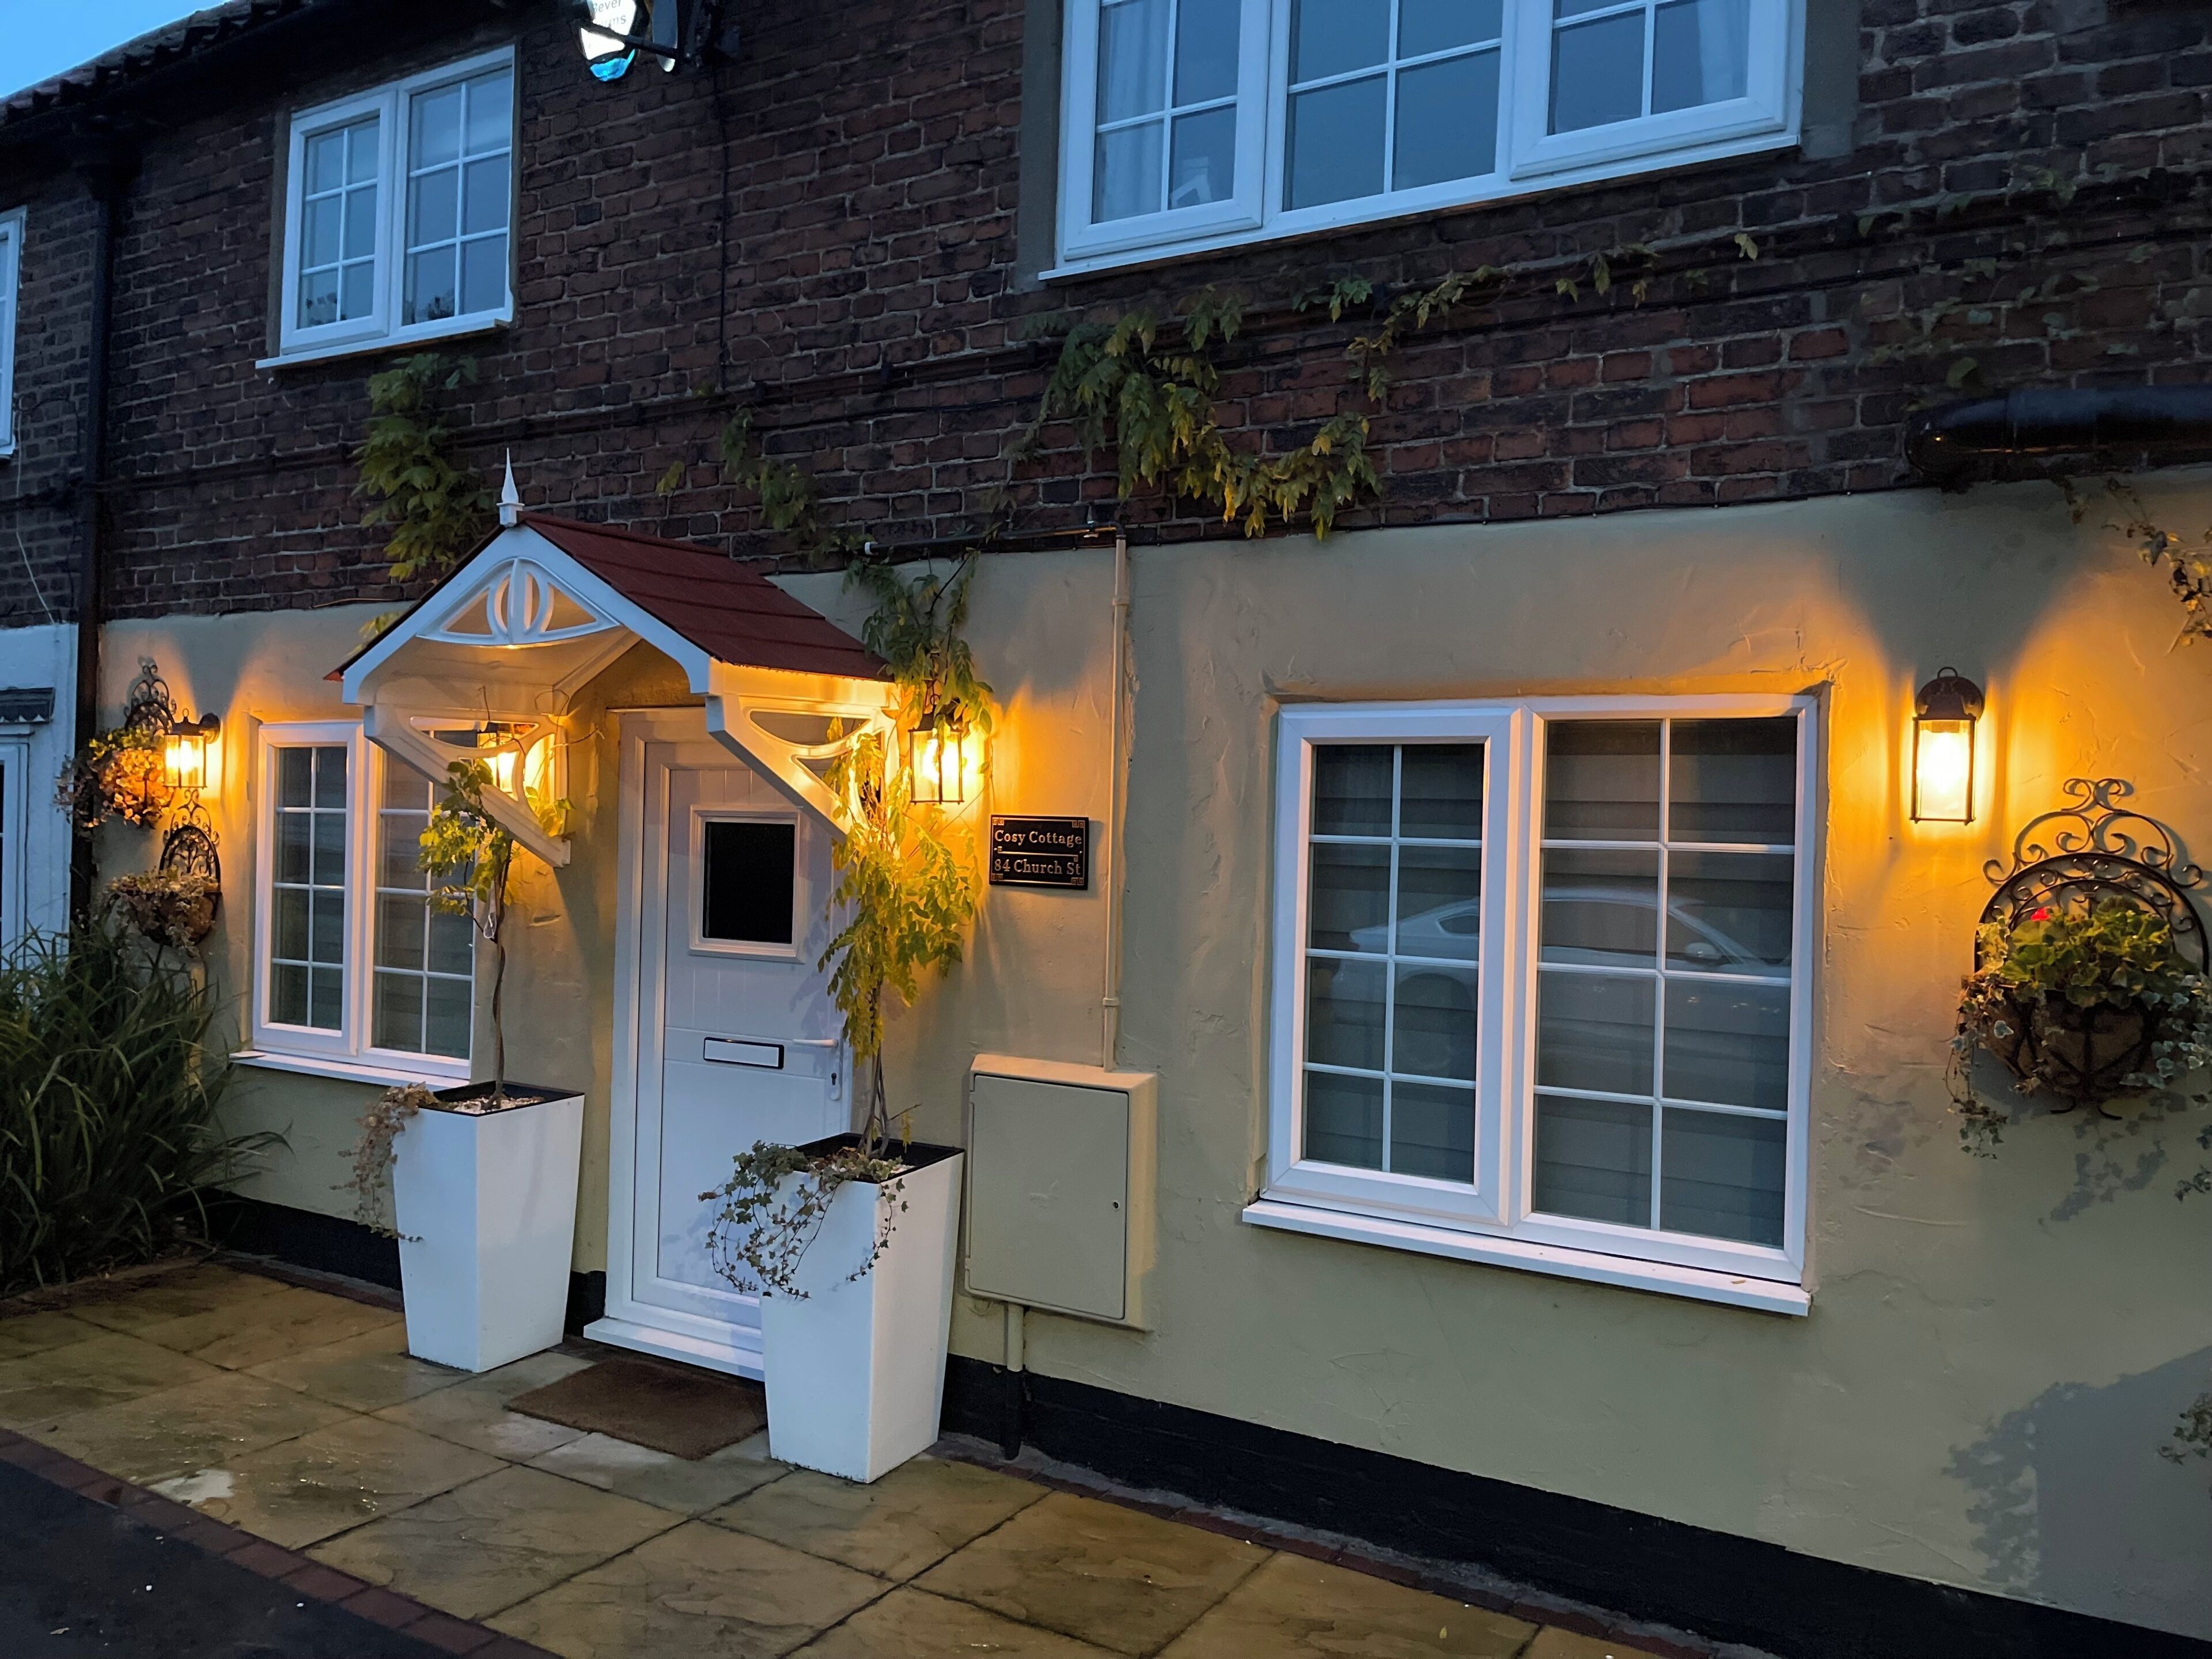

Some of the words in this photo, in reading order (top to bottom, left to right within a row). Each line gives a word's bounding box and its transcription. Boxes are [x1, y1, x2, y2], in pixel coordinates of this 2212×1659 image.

[994, 830, 1025, 846] Cosy
[1029, 831, 1082, 847] Cottage
[994, 859, 1011, 872] 84
[1014, 858, 1062, 874] Church
[1066, 862, 1081, 875] St
